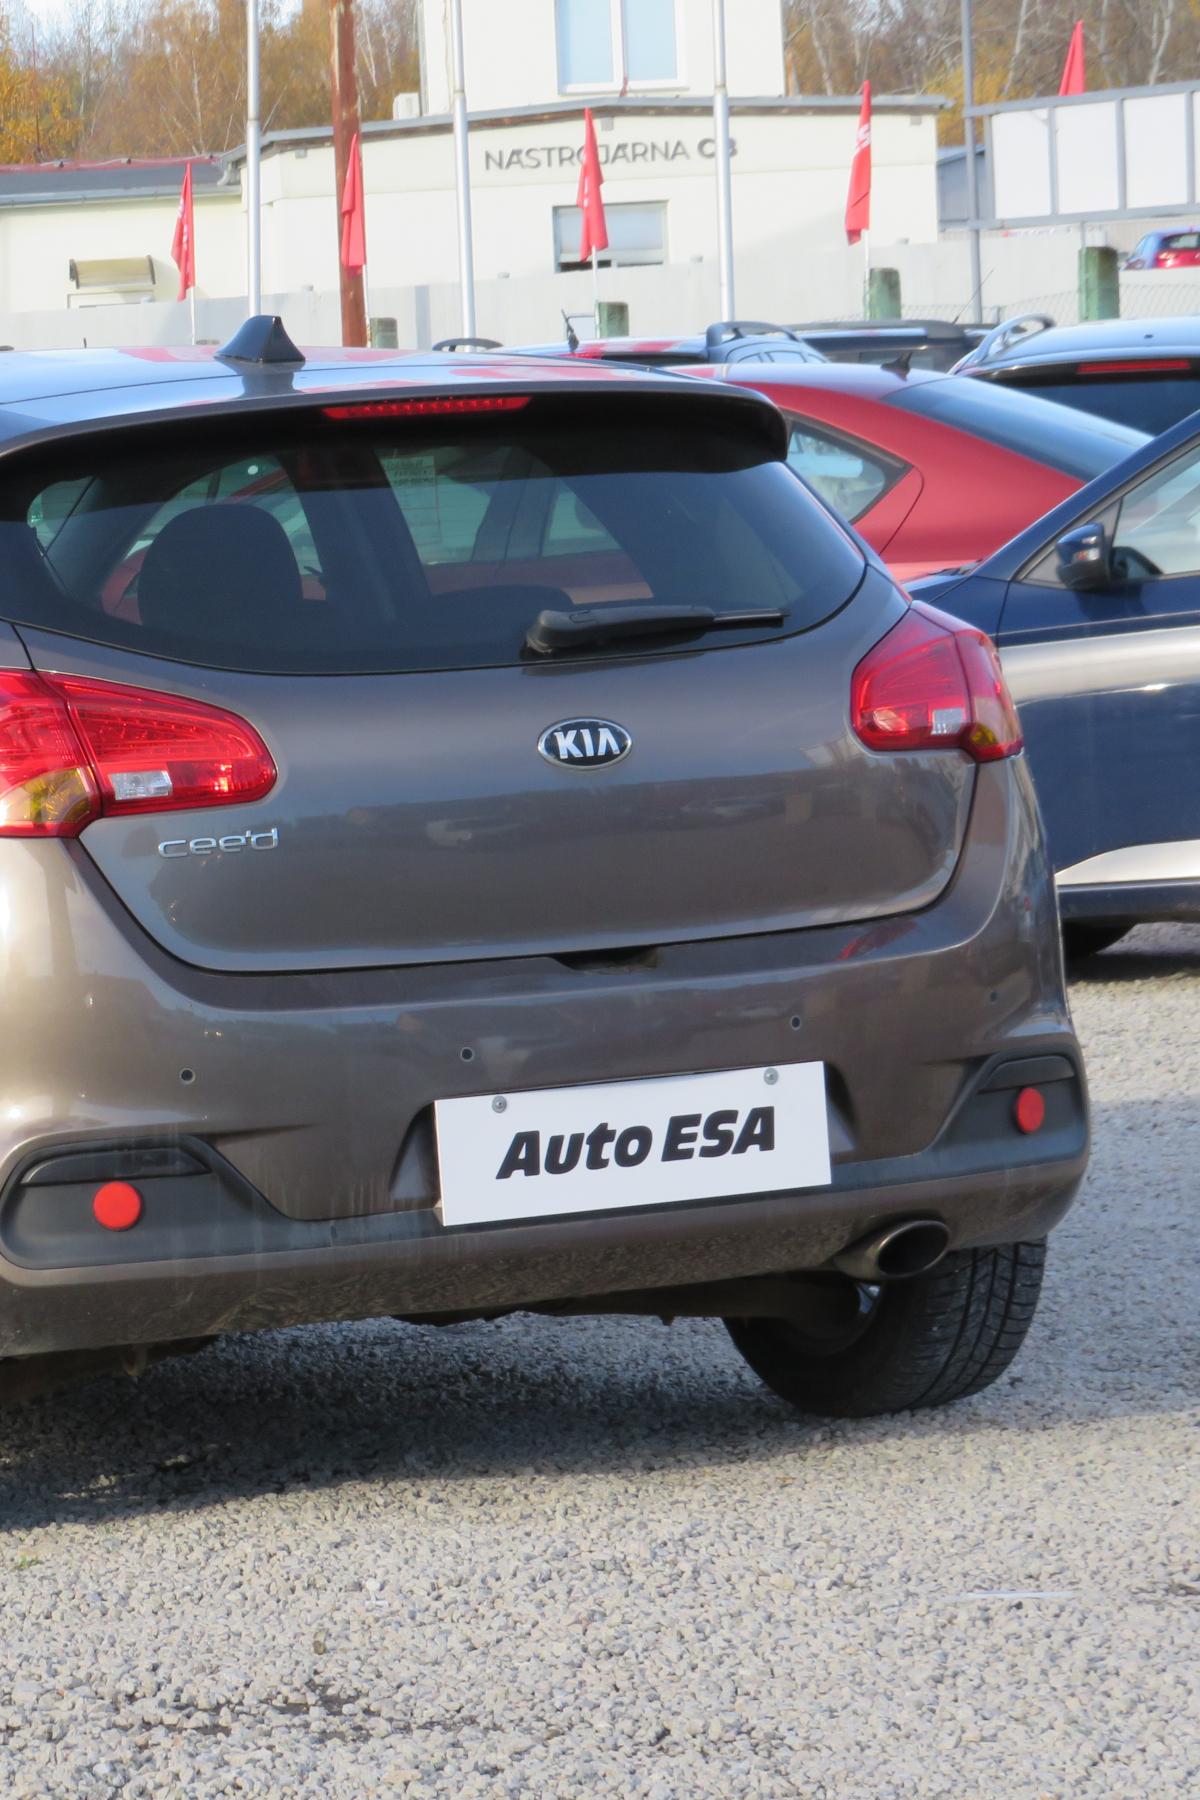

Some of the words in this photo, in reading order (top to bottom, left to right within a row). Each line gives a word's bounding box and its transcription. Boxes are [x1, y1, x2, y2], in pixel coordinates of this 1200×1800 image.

[553, 727, 621, 760] KIA
[494, 1122, 653, 1180] Auto
[661, 1105, 776, 1163] ESA
